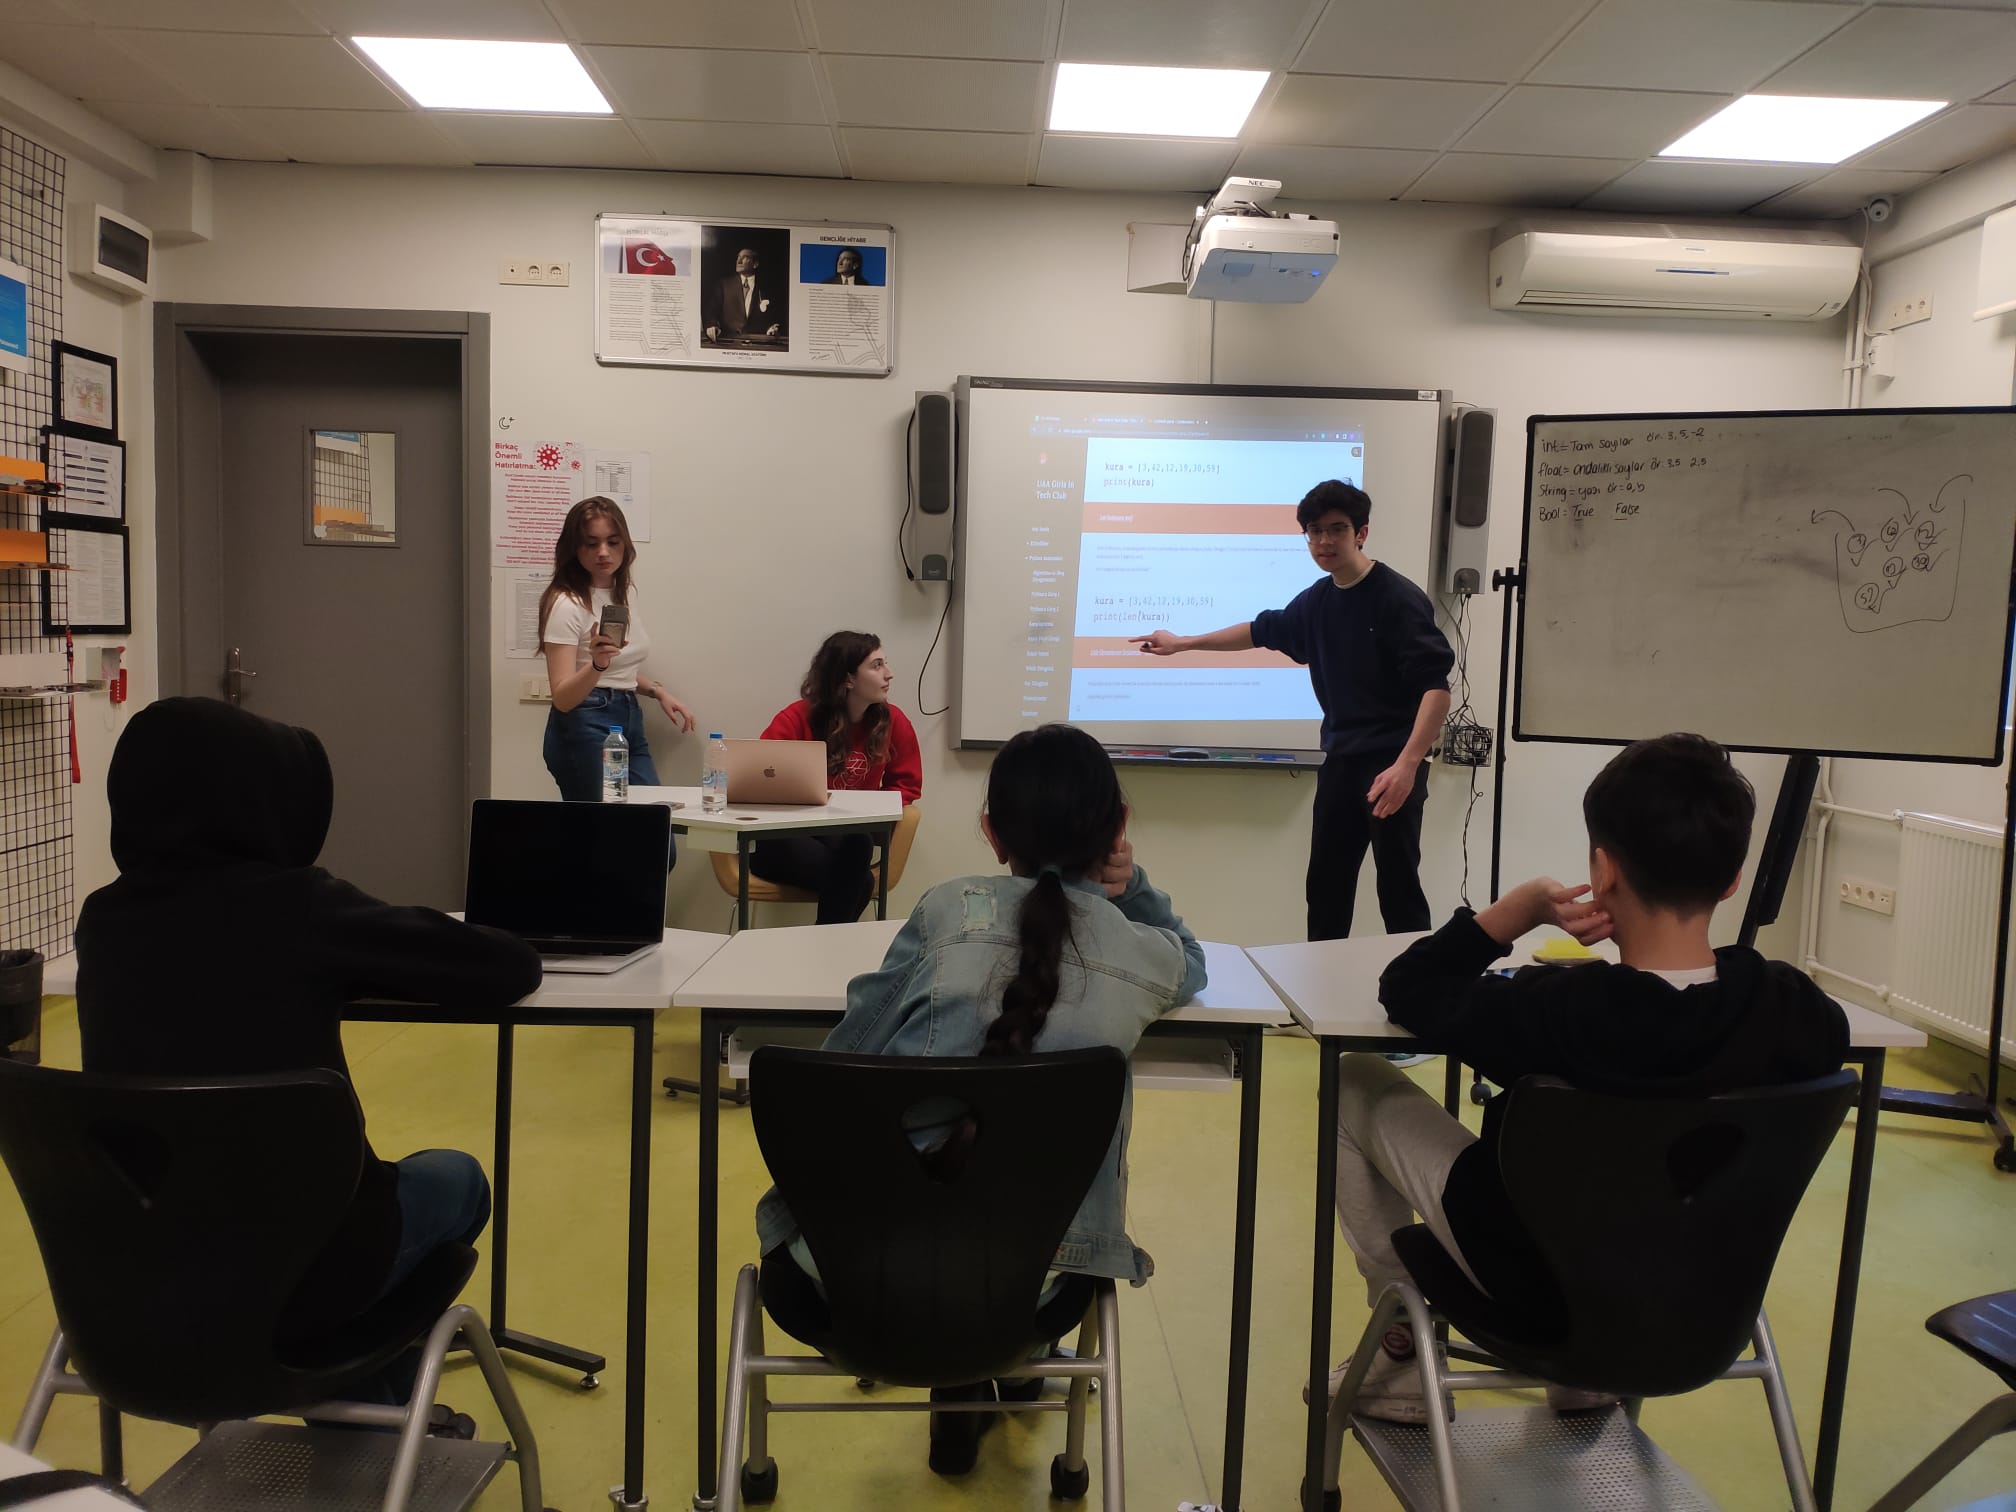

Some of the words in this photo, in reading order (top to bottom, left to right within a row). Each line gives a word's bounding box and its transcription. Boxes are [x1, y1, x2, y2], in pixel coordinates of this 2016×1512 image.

[495, 443, 519, 452] Birkaç
[1570, 440, 1594, 453] Tam
[495, 451, 522, 460] Önemli
[1105, 461, 1123, 472] kura
[1103, 476, 1154, 488] print(kura)
[1036, 490, 1051, 500] Tech
[1052, 491, 1067, 500] Club
[1539, 506, 1560, 522] Bool
[1573, 504, 1595, 518] True
[1615, 502, 1640, 516] False
[1094, 596, 1114, 606] kura
[1093, 612, 1170, 623] print(len(kura))
